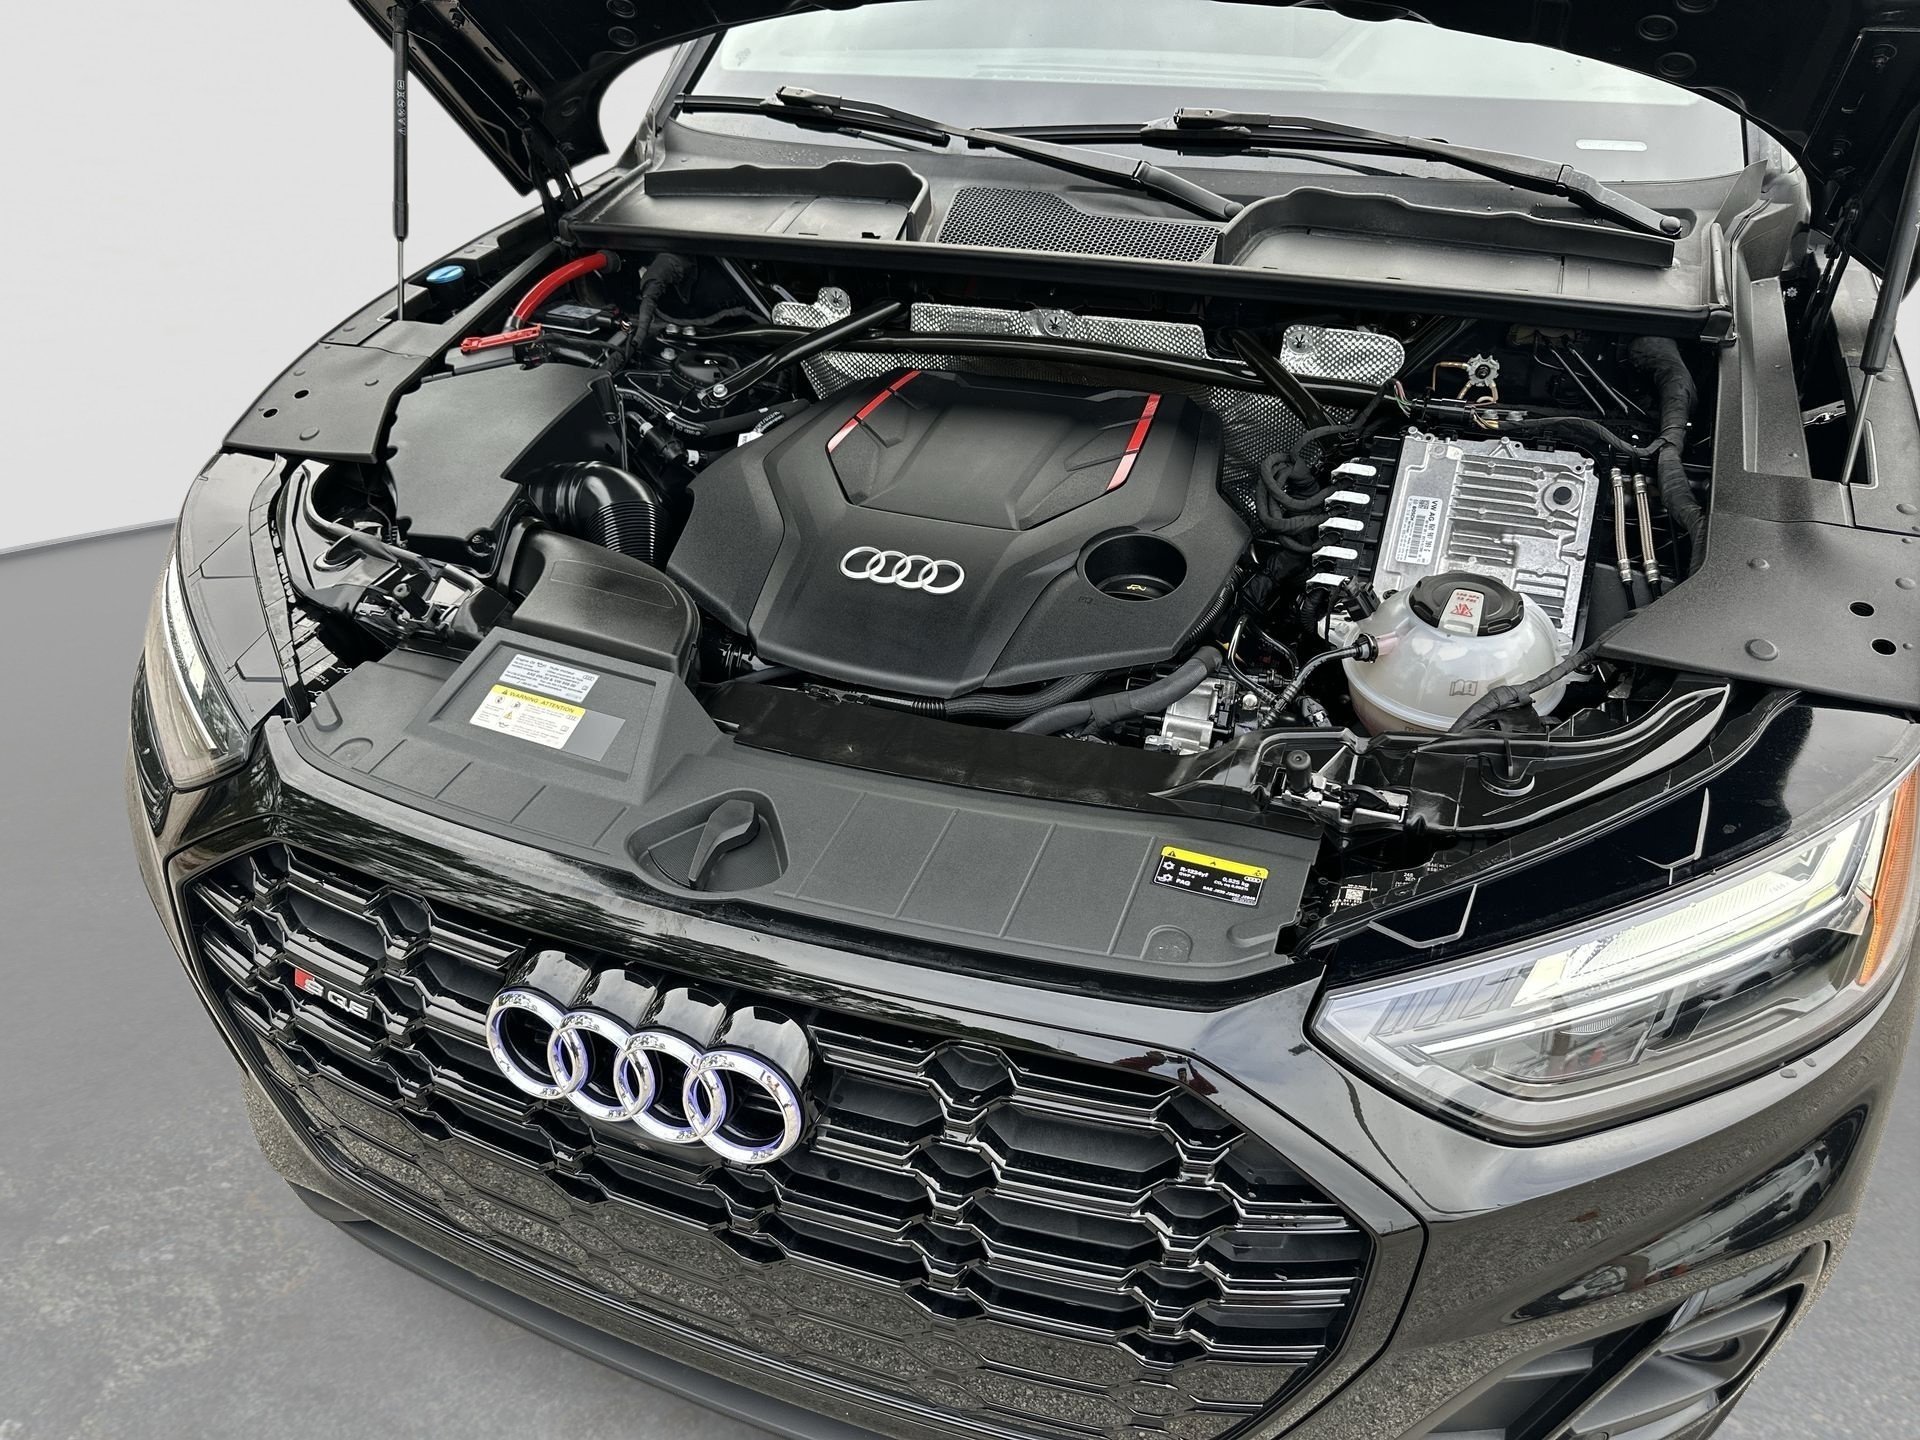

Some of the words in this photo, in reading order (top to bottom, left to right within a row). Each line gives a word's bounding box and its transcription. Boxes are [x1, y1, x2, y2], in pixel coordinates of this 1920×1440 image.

[509, 691, 539, 704] WARNING
[540, 698, 575, 713] ATTENTION
[1179, 866, 1209, 878] R-1234yf
[1175, 878, 1191, 887] PAG
